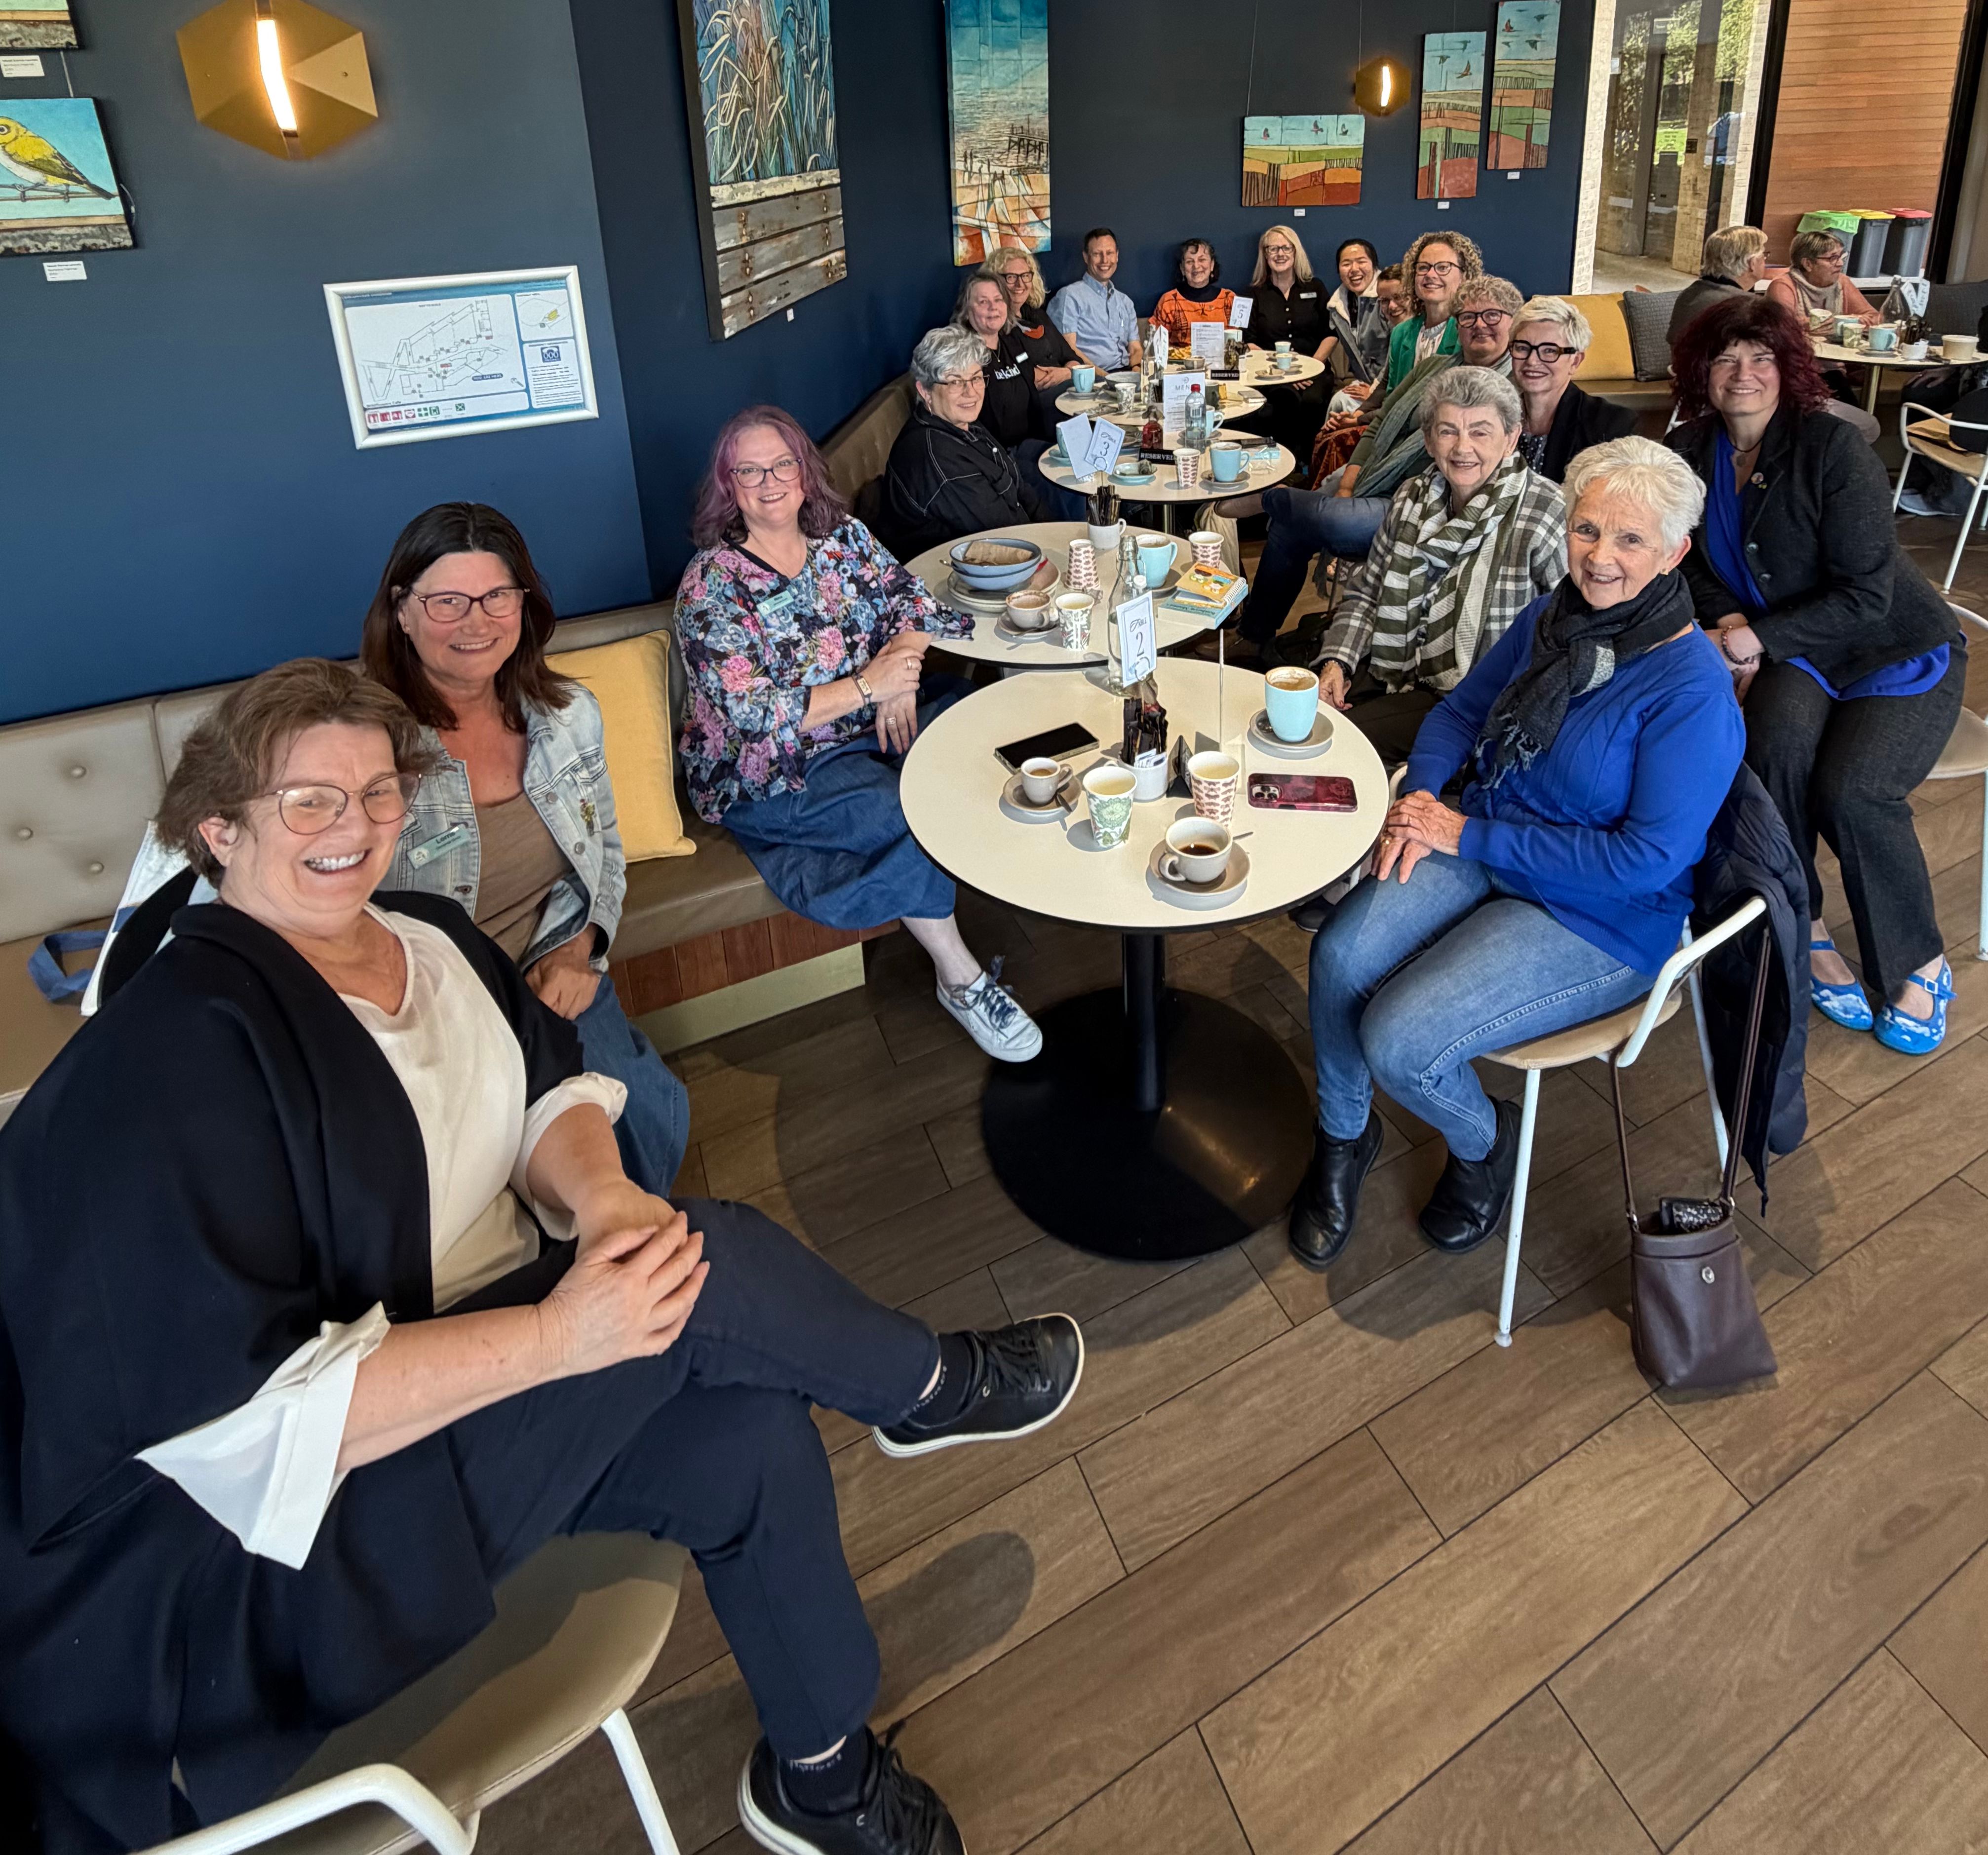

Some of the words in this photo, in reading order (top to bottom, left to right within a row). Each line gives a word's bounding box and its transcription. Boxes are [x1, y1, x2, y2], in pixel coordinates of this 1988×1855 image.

[1238, 309, 1244, 319] 5
[1100, 442, 1109, 456] 3
[1136, 631, 1144, 657] 2
